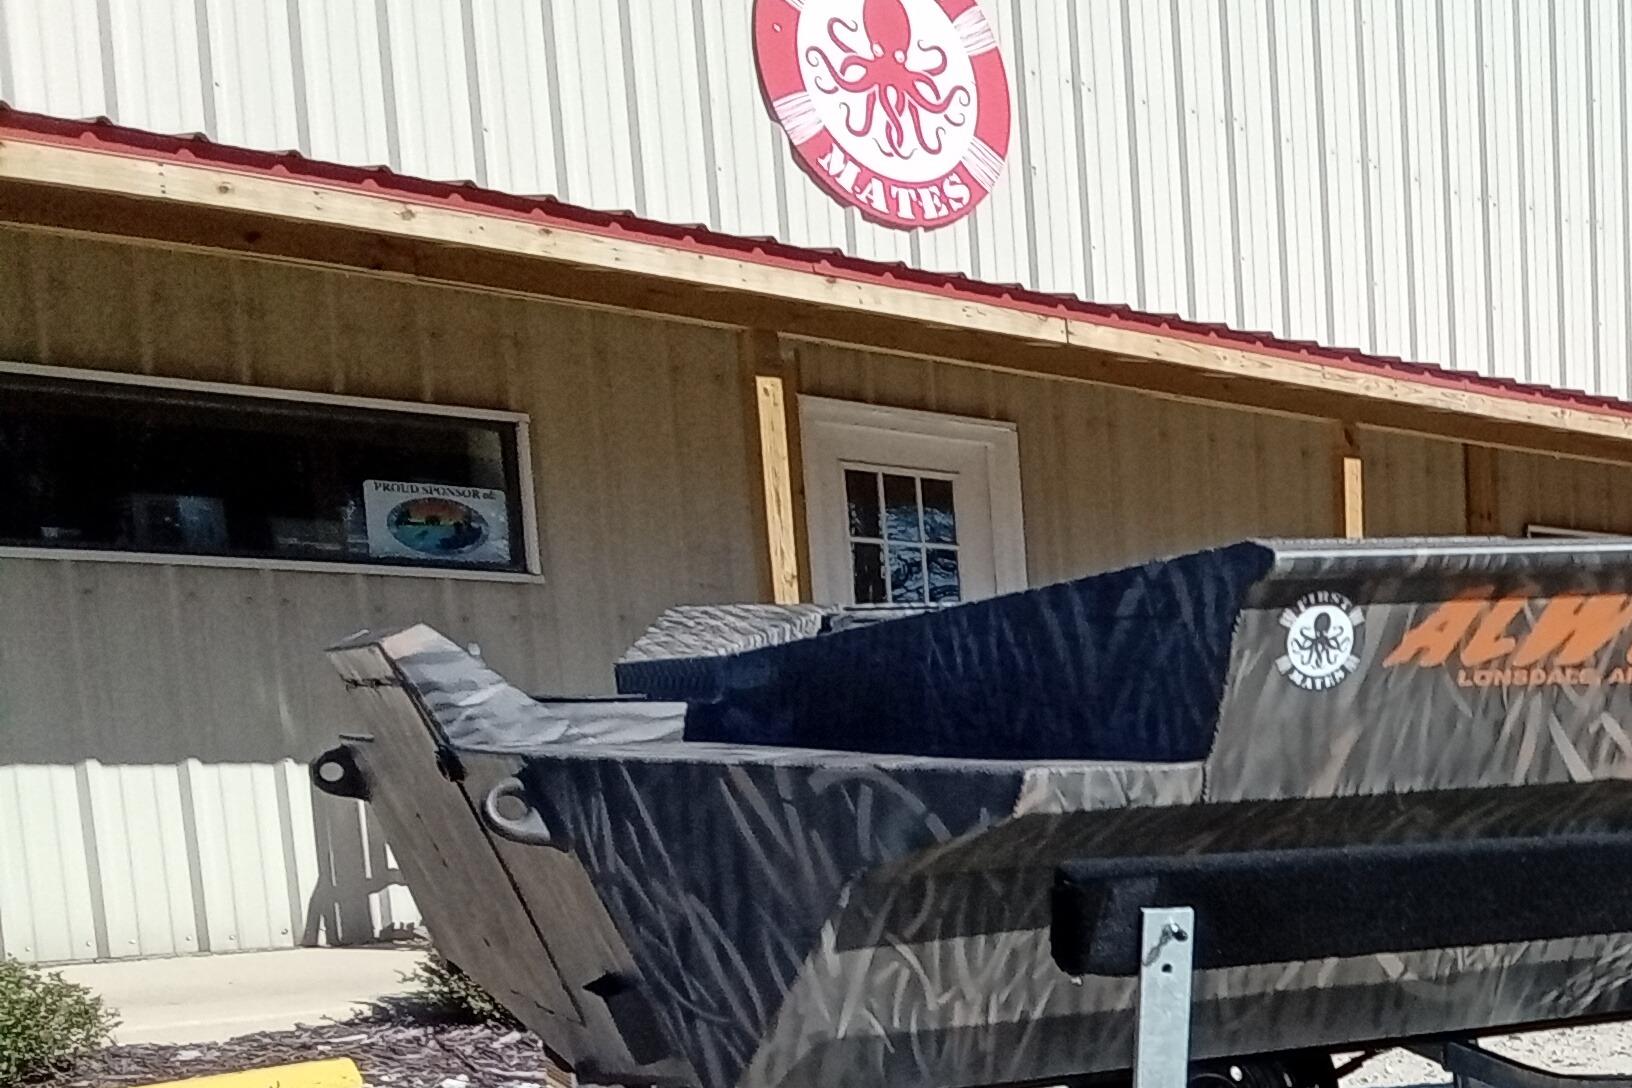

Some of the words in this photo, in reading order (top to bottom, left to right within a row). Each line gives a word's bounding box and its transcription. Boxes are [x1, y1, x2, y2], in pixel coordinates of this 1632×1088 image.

[816, 143, 971, 220] MATES
[374, 482, 419, 493] PROUD
[422, 487, 480, 499] SPONSOR
[1297, 591, 1352, 613] FIRST
[1288, 669, 1345, 690] MATES
